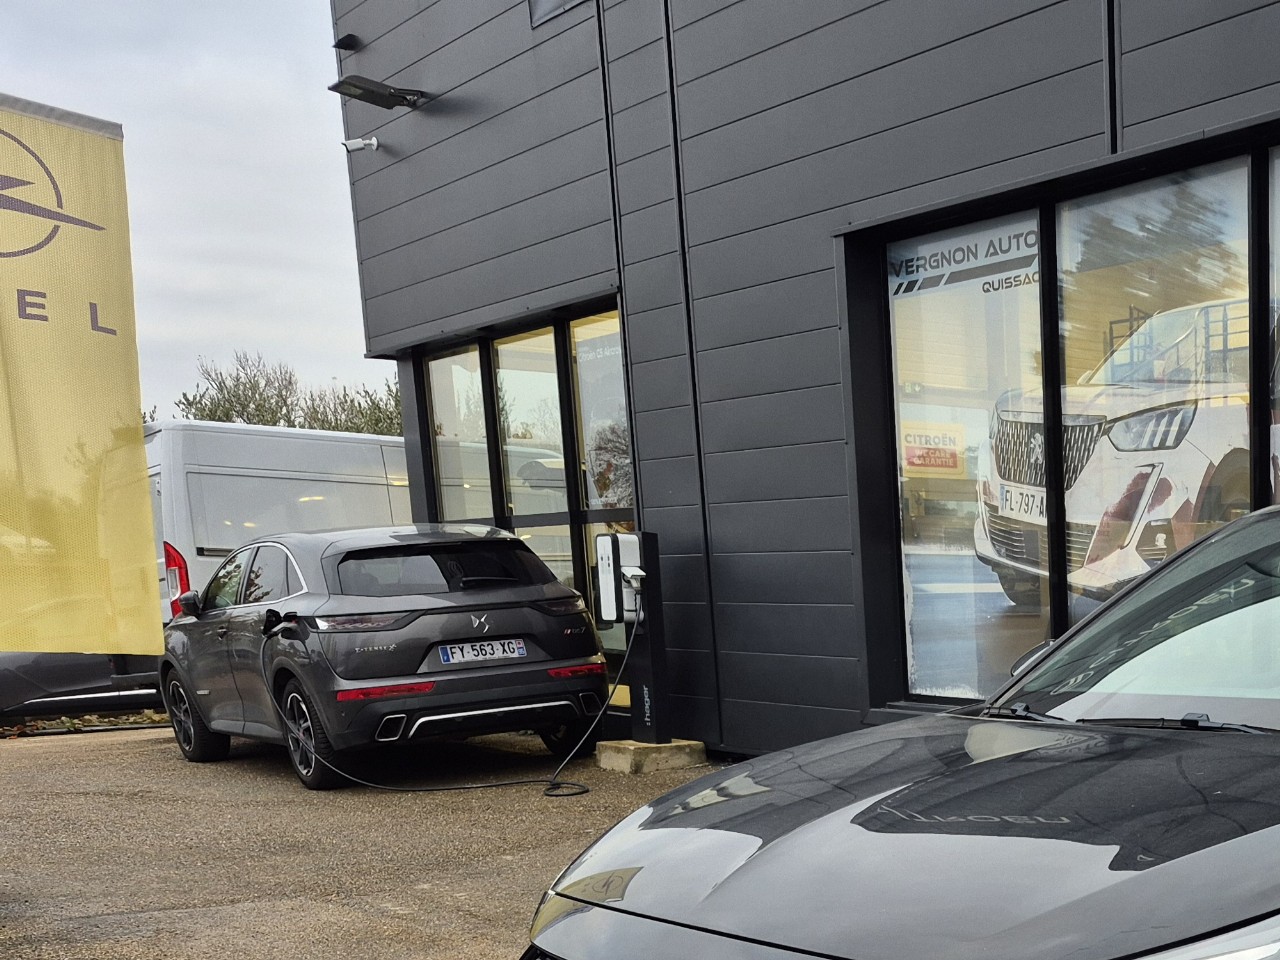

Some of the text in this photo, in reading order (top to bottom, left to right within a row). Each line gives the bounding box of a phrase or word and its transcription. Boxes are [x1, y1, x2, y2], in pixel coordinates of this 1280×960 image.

[890, 229, 1039, 279] VERGNON AUTO
[904, 433, 957, 447] CITROËN
